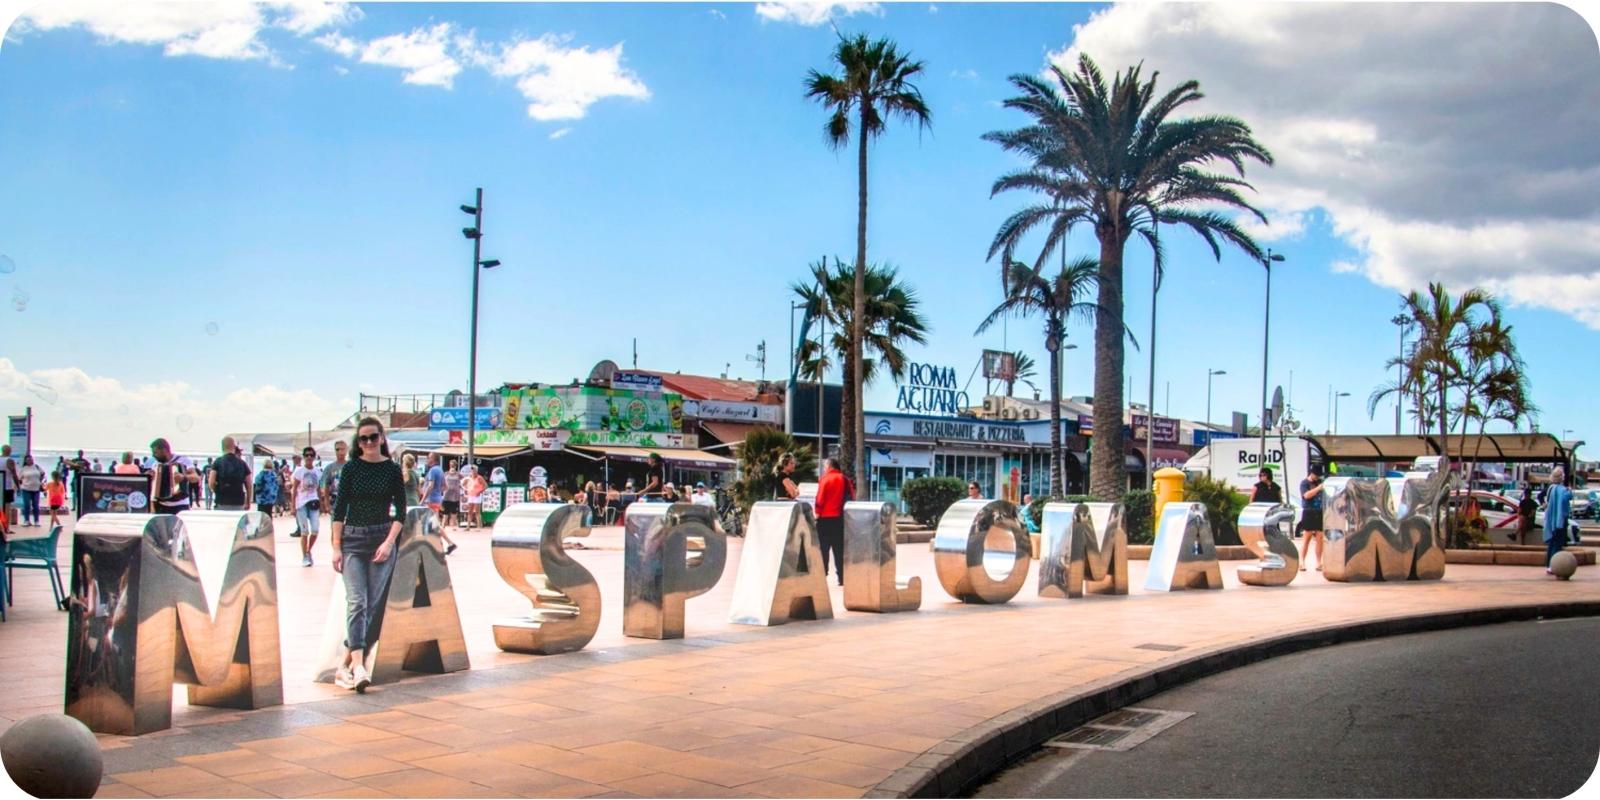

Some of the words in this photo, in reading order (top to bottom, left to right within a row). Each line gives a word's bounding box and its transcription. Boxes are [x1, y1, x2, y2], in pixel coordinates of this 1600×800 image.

[910, 362, 957, 389] ROMA
[913, 420, 976, 439] RESTAURANTE
[978, 426, 985, 440] &
[987, 426, 1025, 441] PIZZERIA
[541, 441, 552, 449] Bar
[64, 498, 1300, 736] MASPALOMAS
